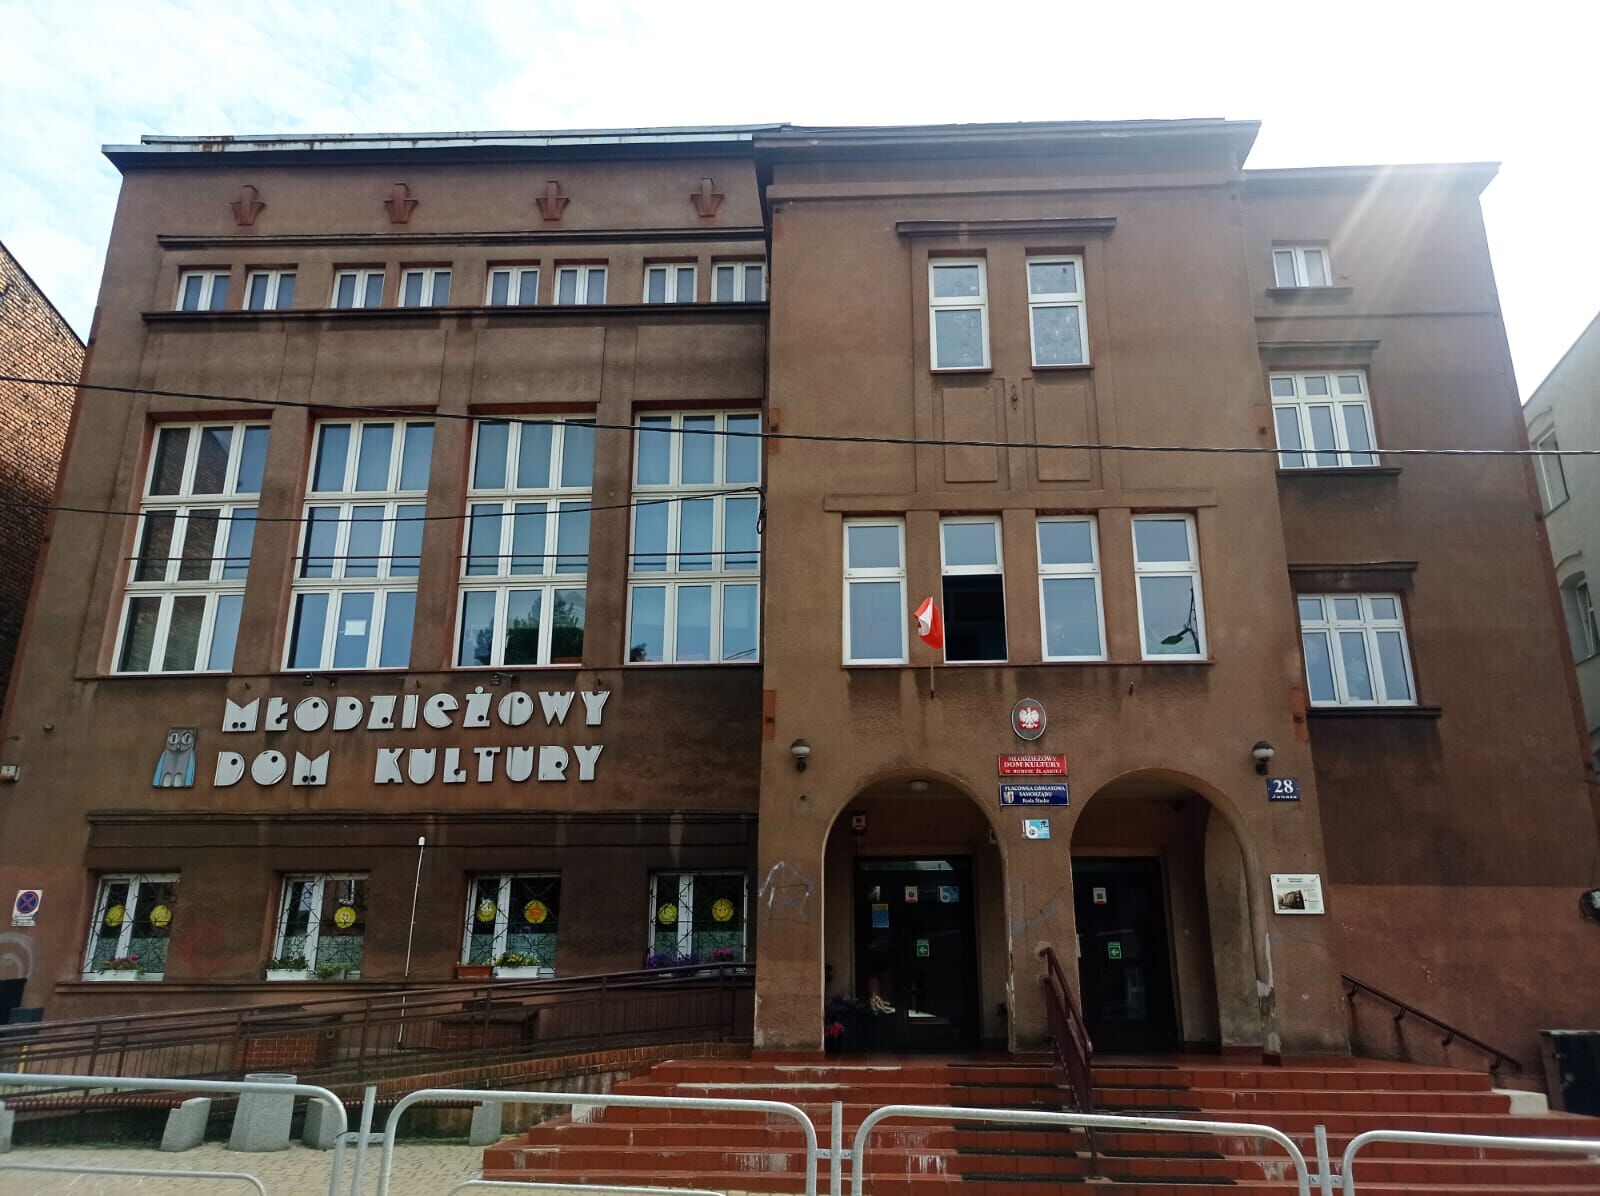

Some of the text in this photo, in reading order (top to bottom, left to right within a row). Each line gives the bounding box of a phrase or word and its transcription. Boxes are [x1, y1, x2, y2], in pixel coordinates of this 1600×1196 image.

[222, 686, 610, 732] MŁODZIEŻOWY
[213, 744, 604, 787] DOM KULTURY
[1273, 779, 1294, 793] 28
